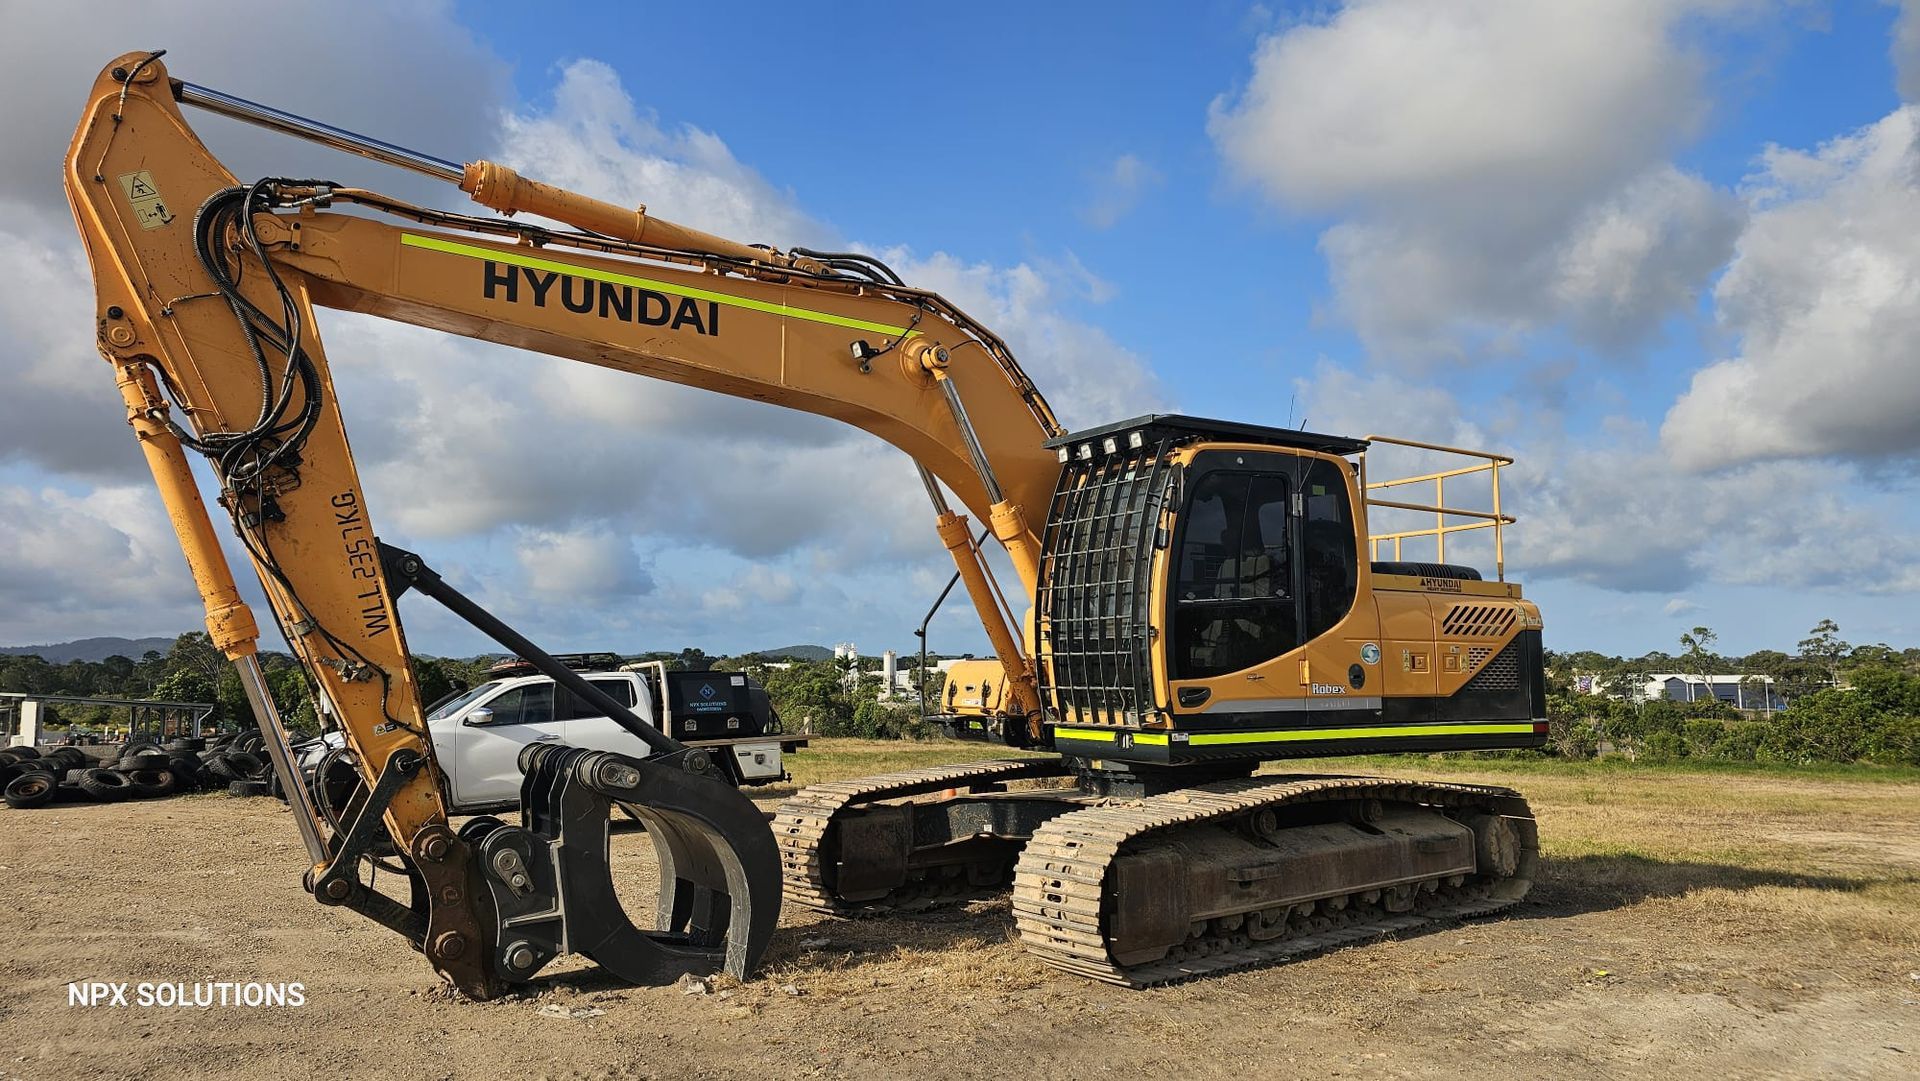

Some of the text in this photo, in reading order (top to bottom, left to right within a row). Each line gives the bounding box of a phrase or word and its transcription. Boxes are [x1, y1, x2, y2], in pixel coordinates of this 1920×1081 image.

[483, 260, 719, 337] HYUNDAI
[1426, 578, 1462, 588] HYUNDAI
[1312, 683, 1346, 694] Robex
